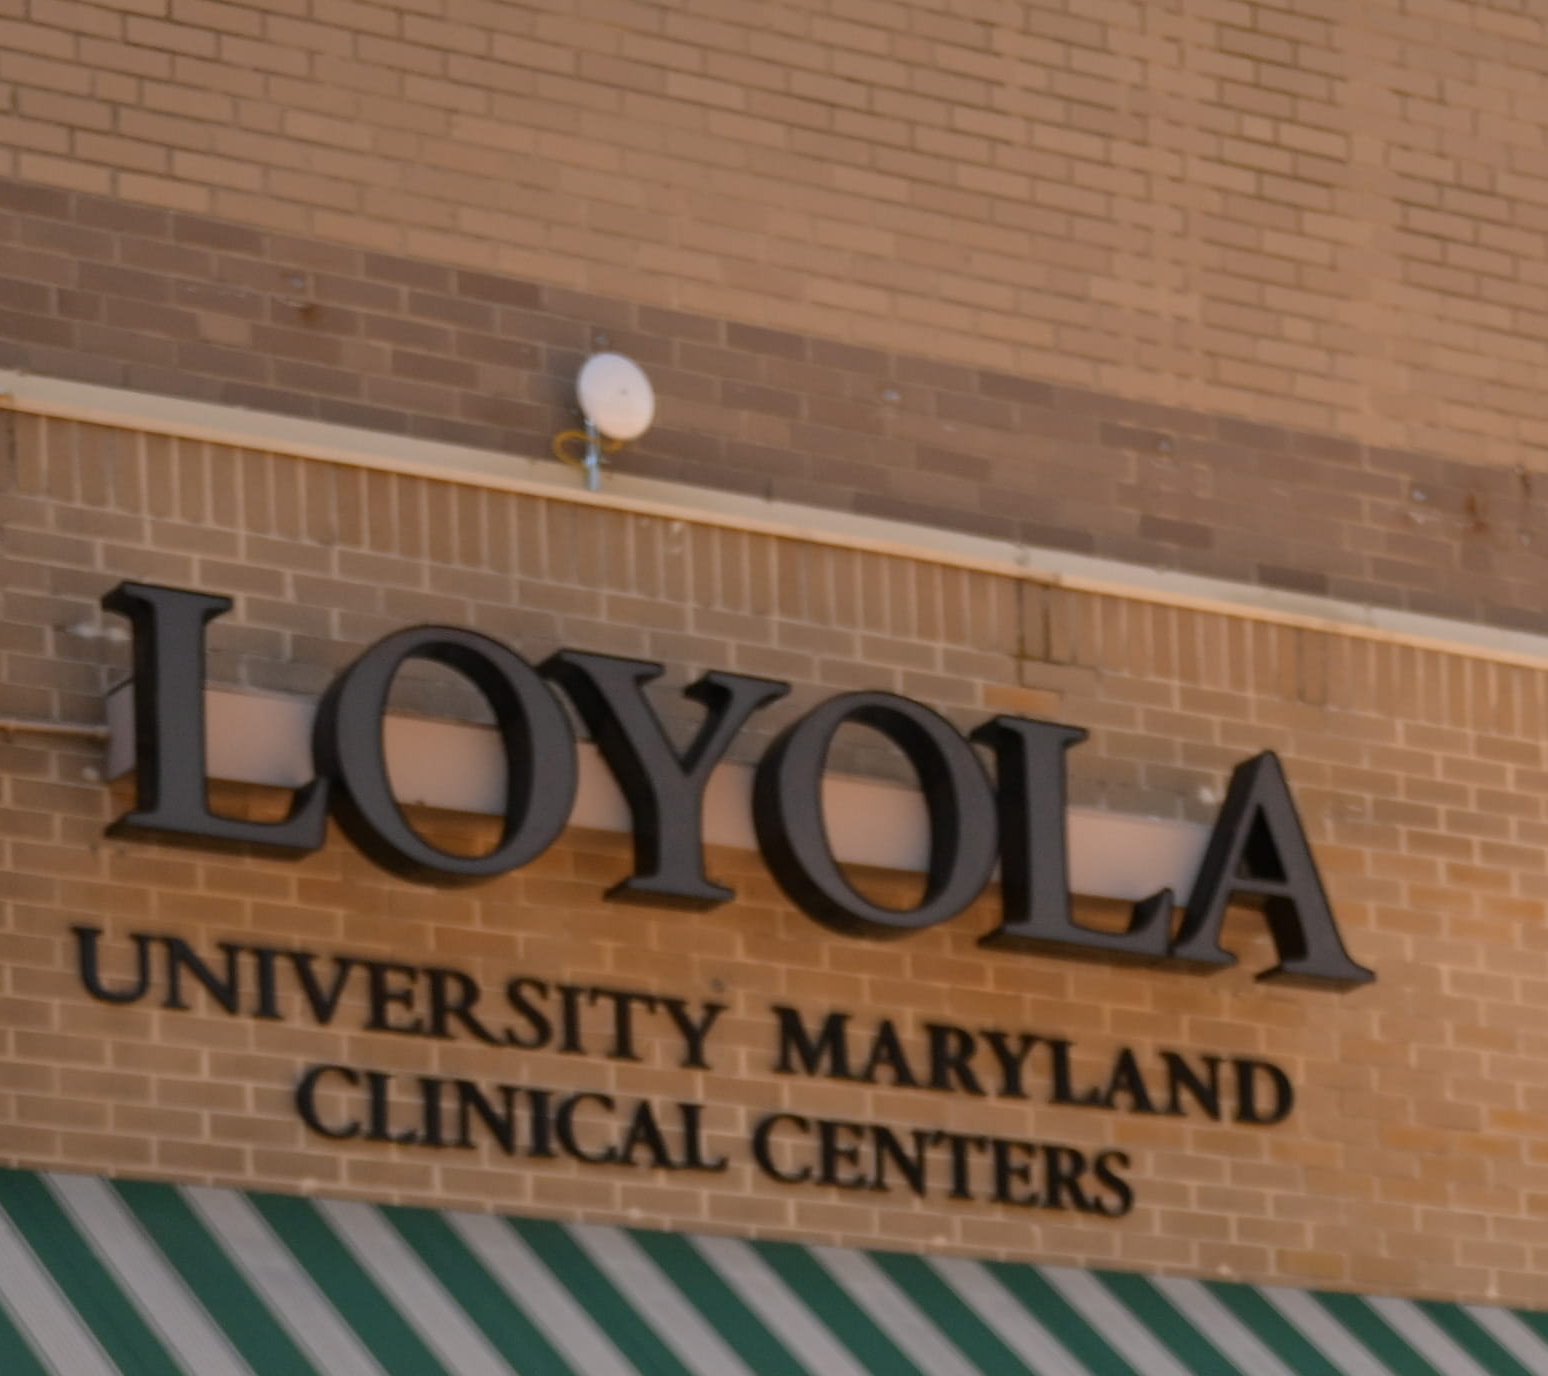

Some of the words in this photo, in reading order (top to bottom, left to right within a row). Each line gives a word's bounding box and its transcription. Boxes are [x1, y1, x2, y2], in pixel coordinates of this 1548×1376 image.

[101, 579, 1378, 994] LOYOLA
[72, 926, 727, 1072] UNIVERSITY
[772, 1005, 1294, 1129] MARYLAND
[295, 1063, 727, 1175] CLINICAL
[752, 1112, 1135, 1220] CENTERS
